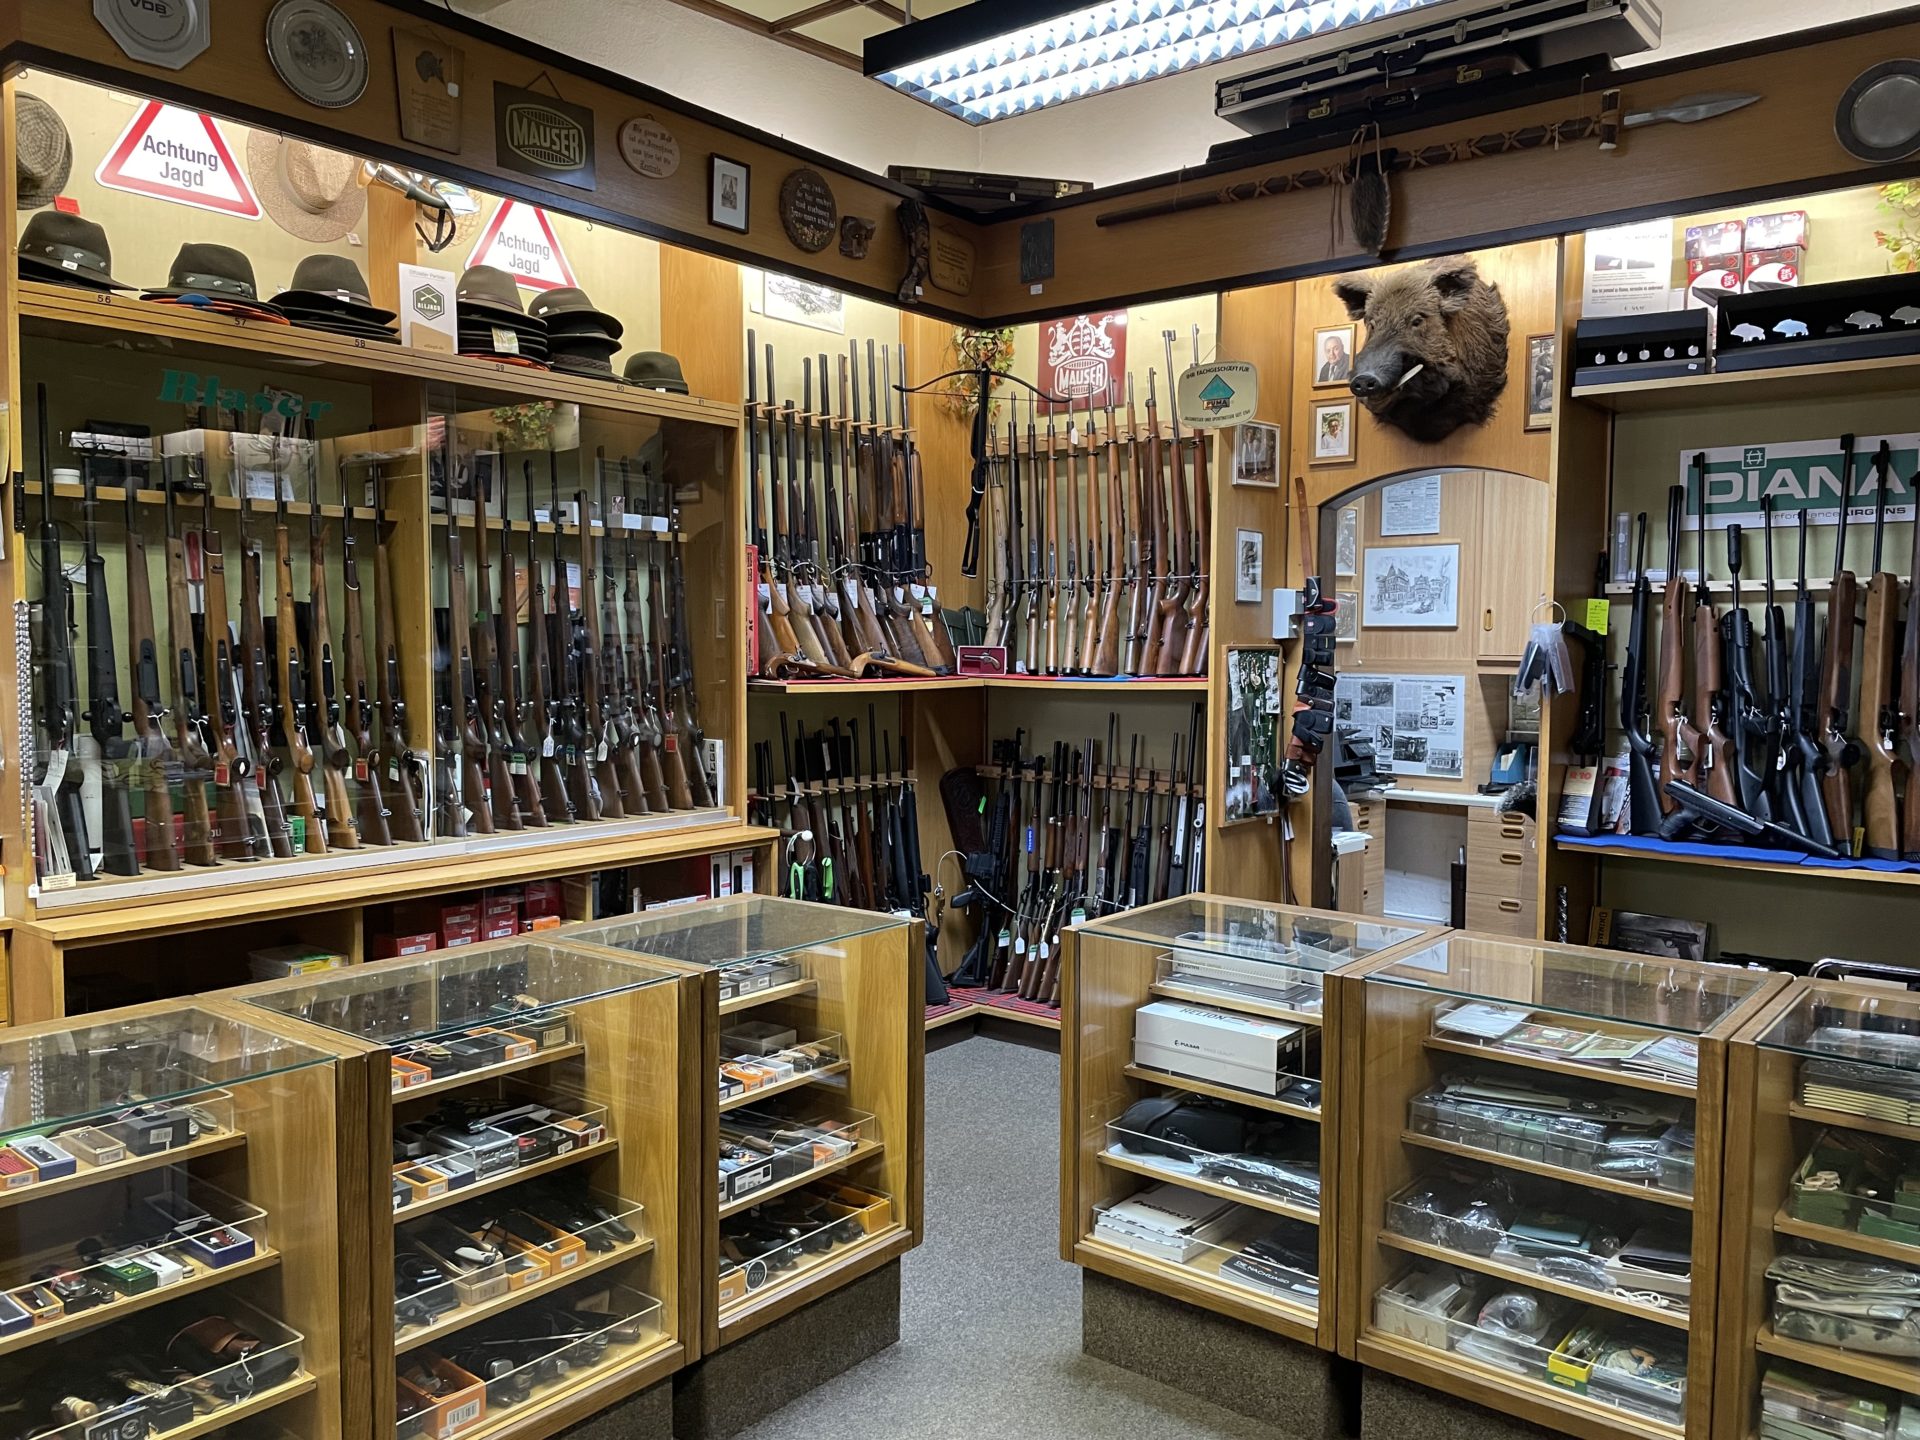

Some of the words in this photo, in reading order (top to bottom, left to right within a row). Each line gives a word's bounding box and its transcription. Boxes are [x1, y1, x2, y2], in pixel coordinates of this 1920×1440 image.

[512, 110, 580, 164] MAUSER
[143, 134, 218, 171] Achtung
[159, 161, 204, 187] Jagd
[497, 232, 550, 260] Achtung
[508, 253, 540, 274] Jagd
[97, 294, 111, 304] 56
[234, 317, 247, 326] 57
[1060, 362, 1104, 392] MAUSER
[156, 368, 334, 421] Blaser
[1206, 400, 1228, 408] PUMA
[1702, 462, 1907, 504] DIANA
[1759, 510, 1840, 521] Prforance
[1845, 506, 1906, 516] IRGNS
